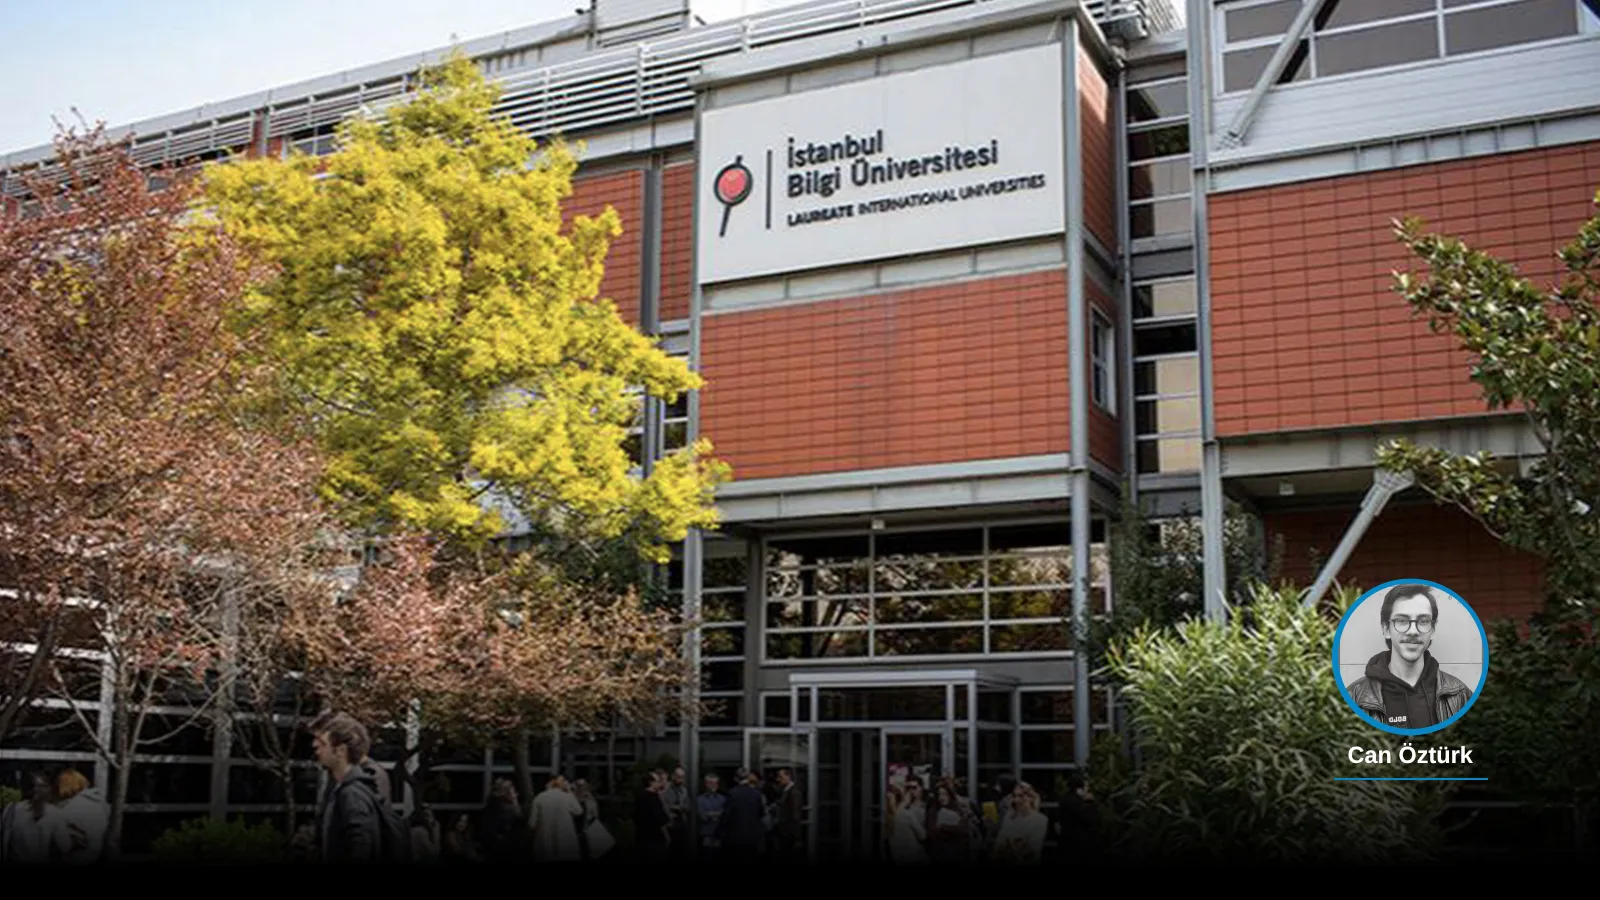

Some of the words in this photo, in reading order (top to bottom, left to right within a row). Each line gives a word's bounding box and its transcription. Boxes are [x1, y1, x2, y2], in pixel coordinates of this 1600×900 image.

[787, 130, 884, 168] İstanbul
[787, 166, 841, 198] Bilgi
[850, 140, 999, 186] Üniversitesi
[787, 205, 854, 226] LAUREATE
[858, 190, 958, 216] INTERNATIONAL
[961, 174, 1046, 200] UNIVERSITIES
